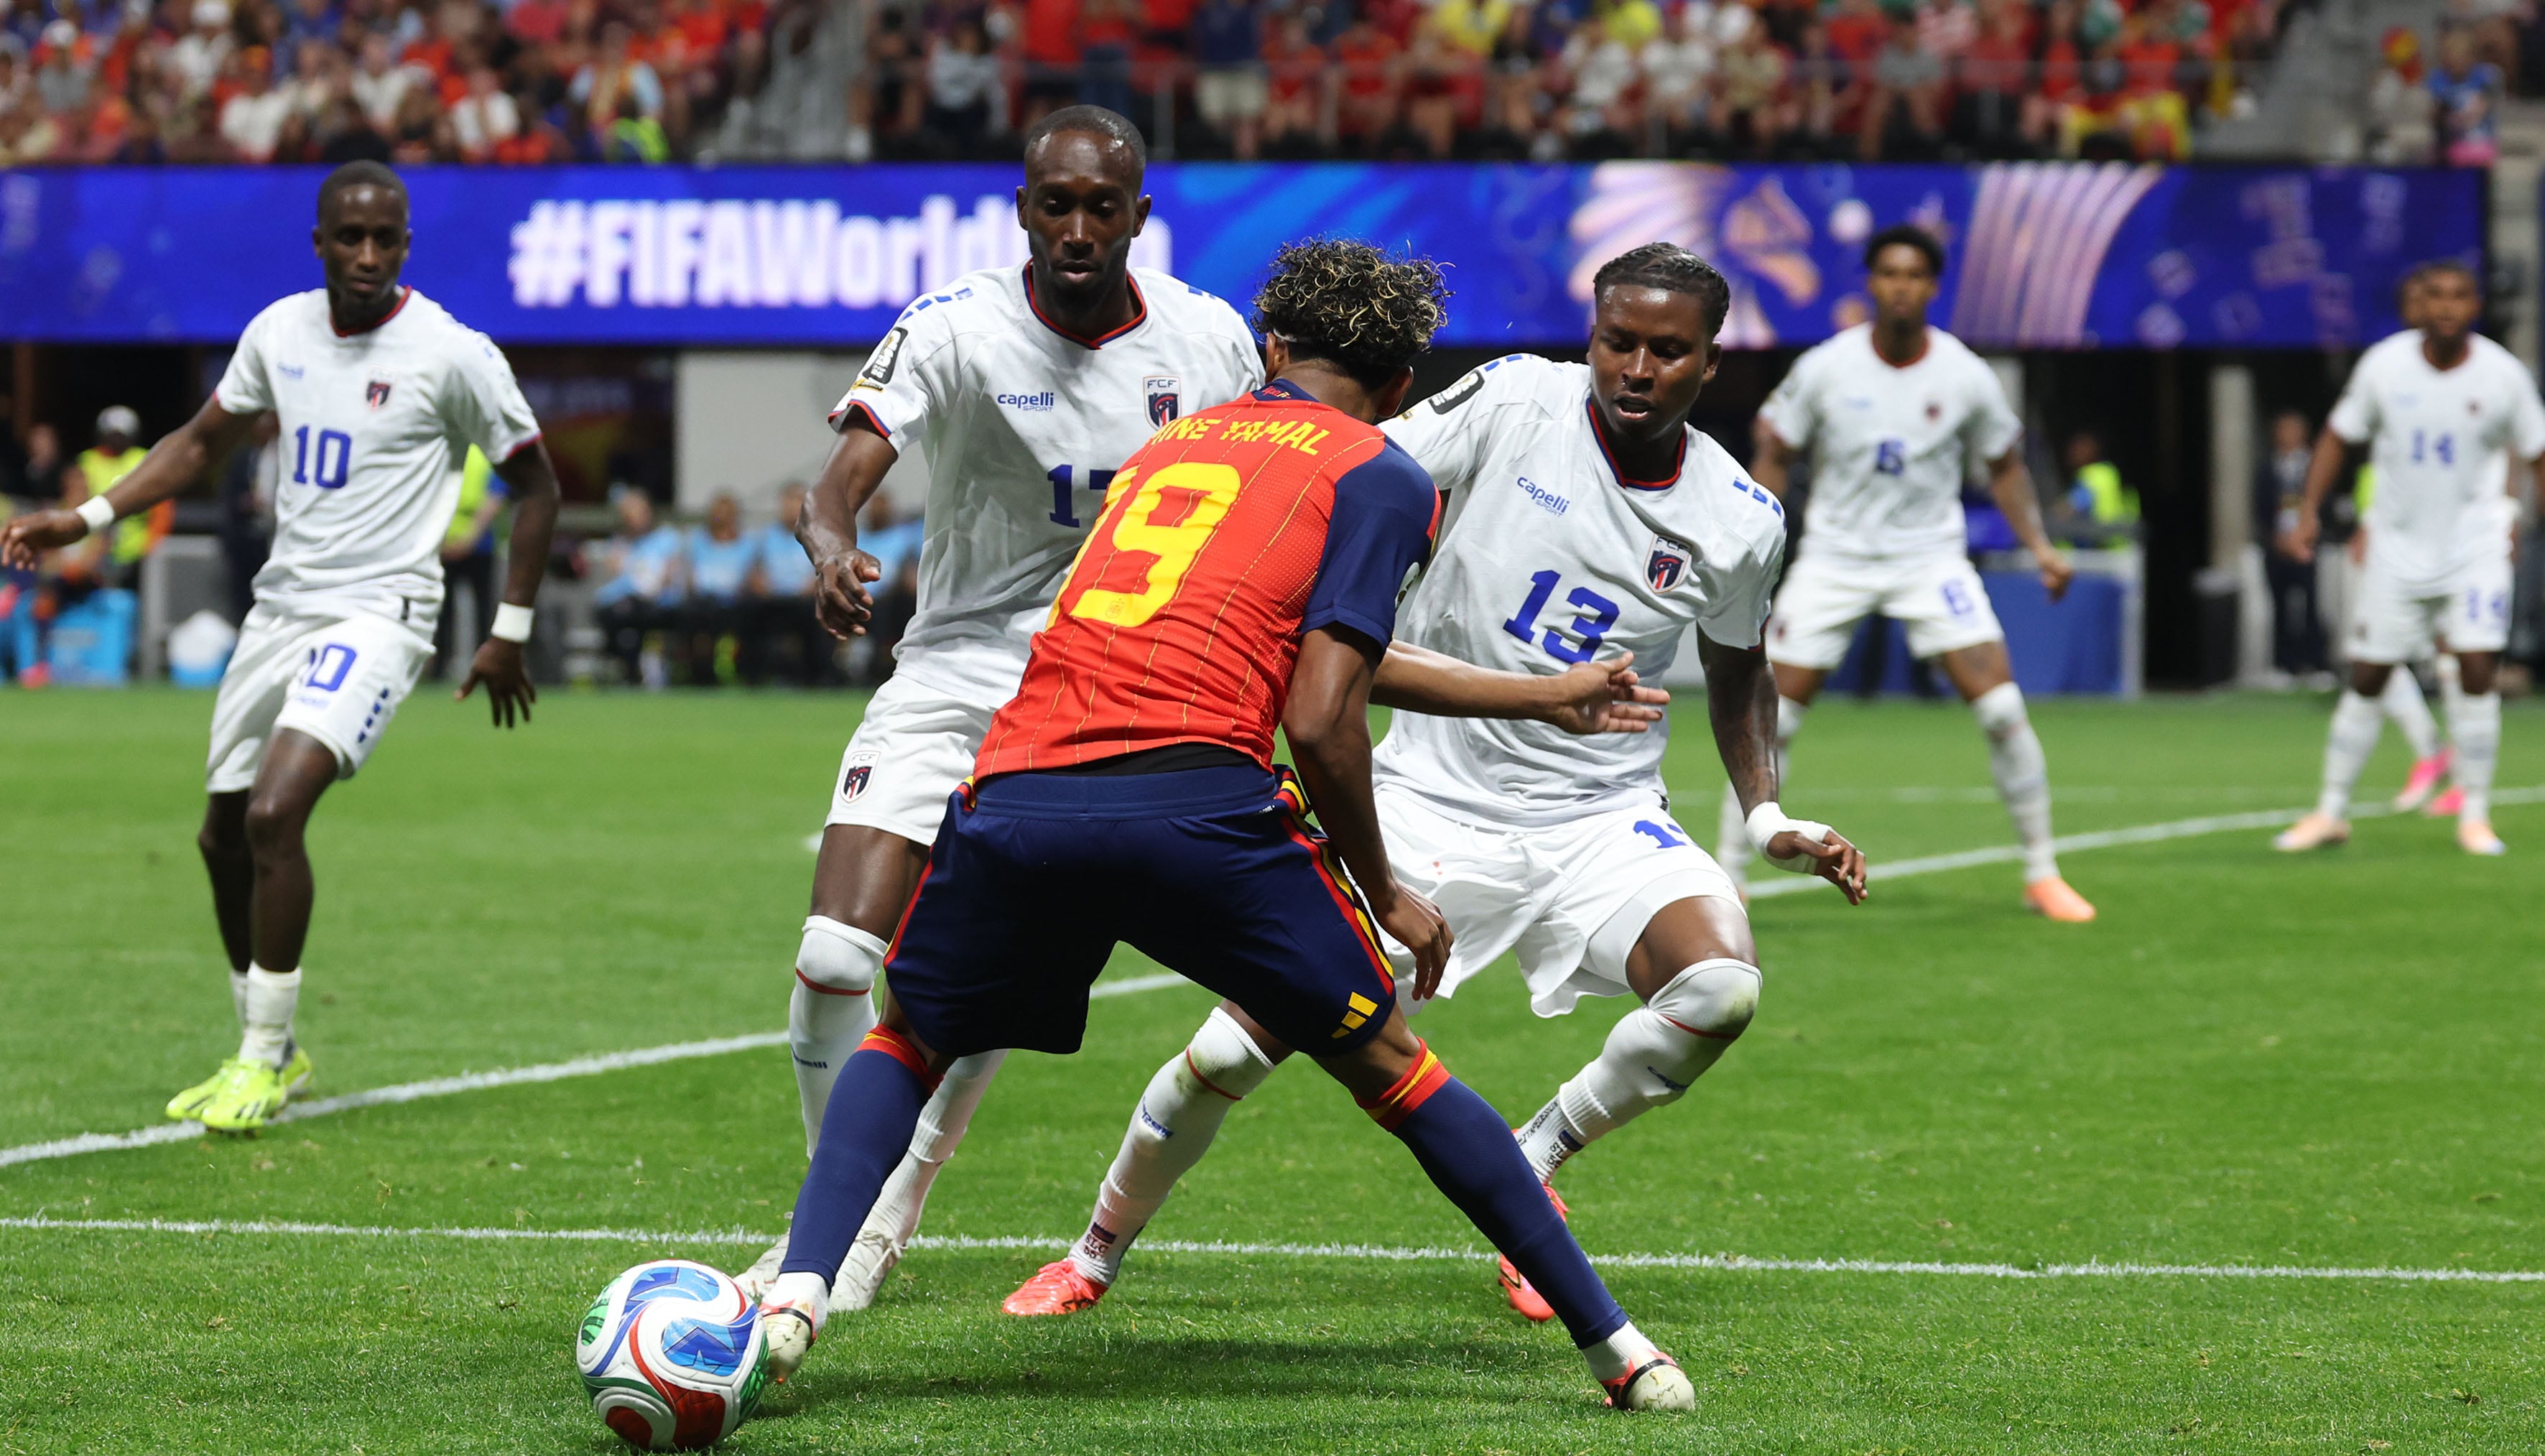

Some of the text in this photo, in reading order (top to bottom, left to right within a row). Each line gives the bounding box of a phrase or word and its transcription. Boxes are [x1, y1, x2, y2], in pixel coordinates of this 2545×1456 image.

[508, 195, 1173, 307] #FIFAWorld
[997, 392, 1054, 409] capelli
[1147, 379, 1177, 389] FCF
[1220, 421, 1330, 455] YAMAL
[293, 425, 351, 489] 10
[1876, 440, 1904, 476] 6
[1517, 477, 1570, 513] capelli
[1535, 499, 1563, 516] SPORT
[1656, 537, 1689, 551] FCF
[1503, 570, 1620, 664] 13
[1633, 820, 1687, 848] 1
